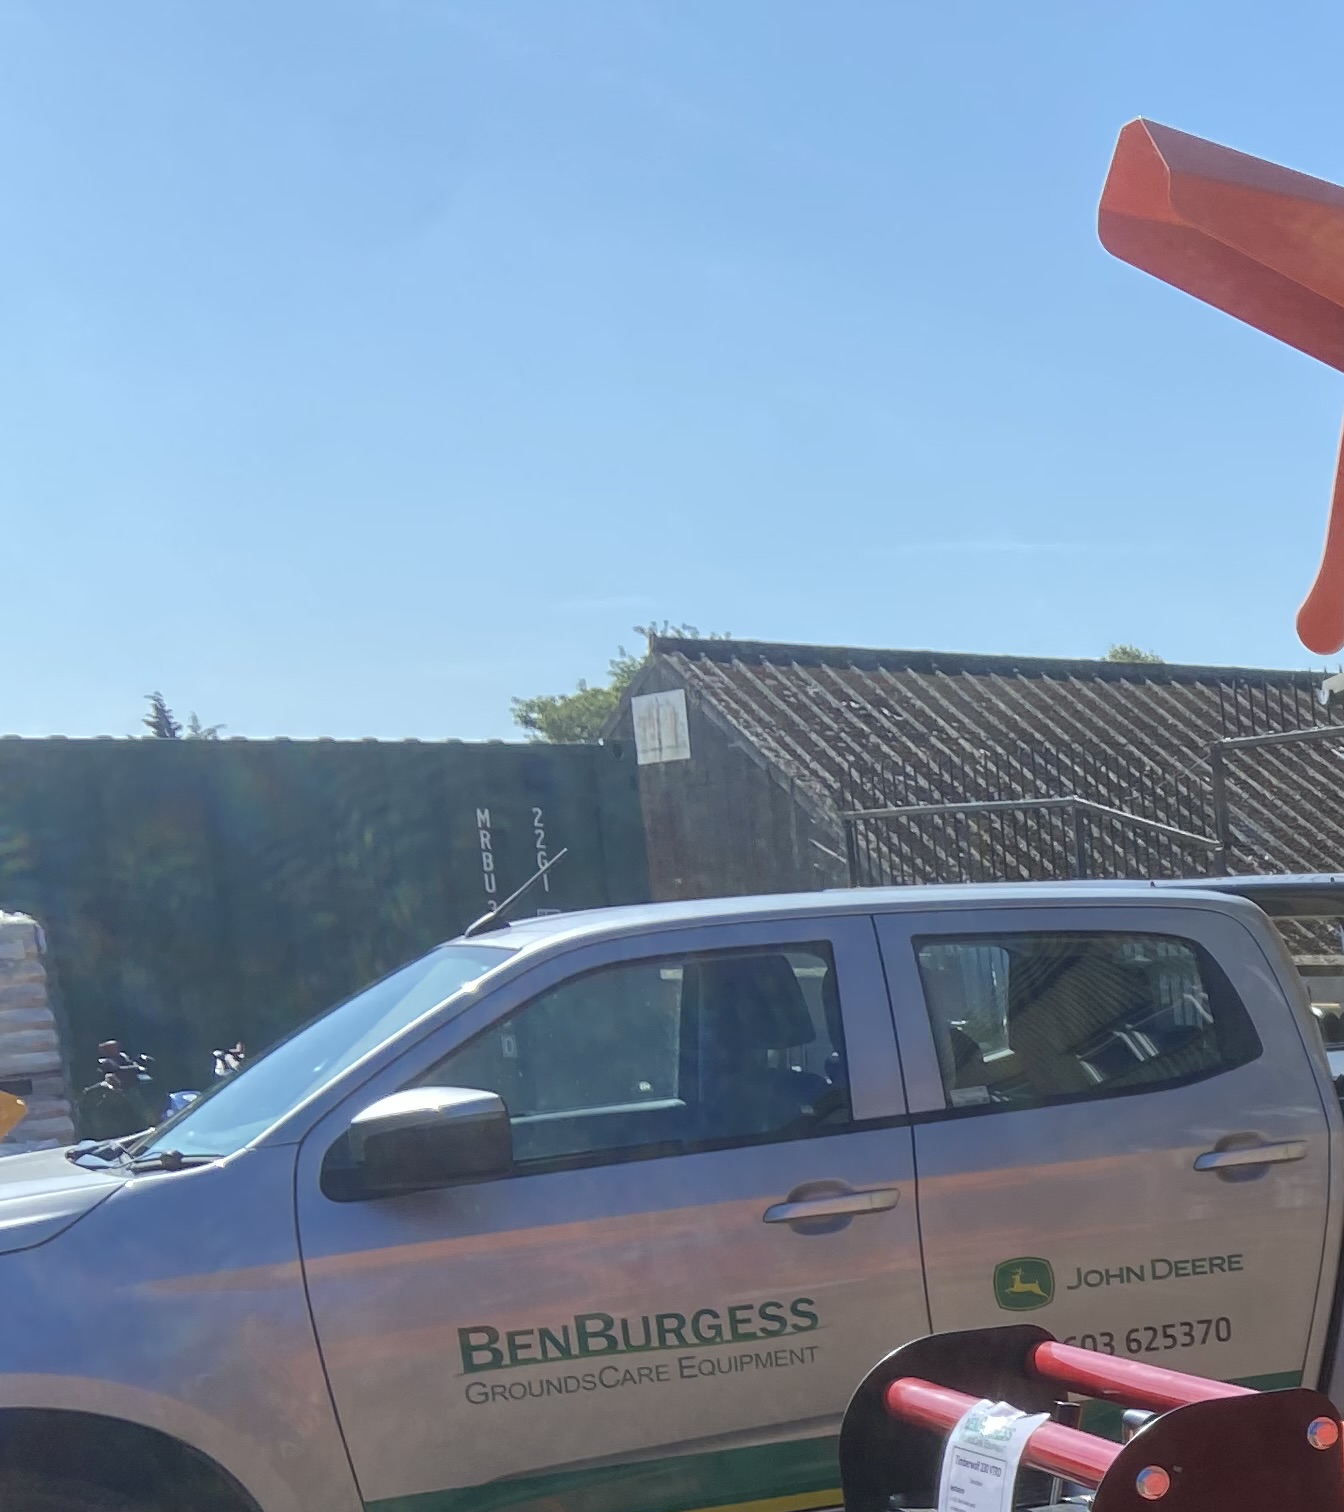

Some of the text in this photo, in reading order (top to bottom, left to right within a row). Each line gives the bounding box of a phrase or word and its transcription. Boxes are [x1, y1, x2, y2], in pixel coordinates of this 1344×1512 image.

[1066, 1254, 1244, 1290] JOHN DEERE
[1125, 1316, 1232, 1355] 625370
[677, 1345, 820, 1380] EQUIPMENT
